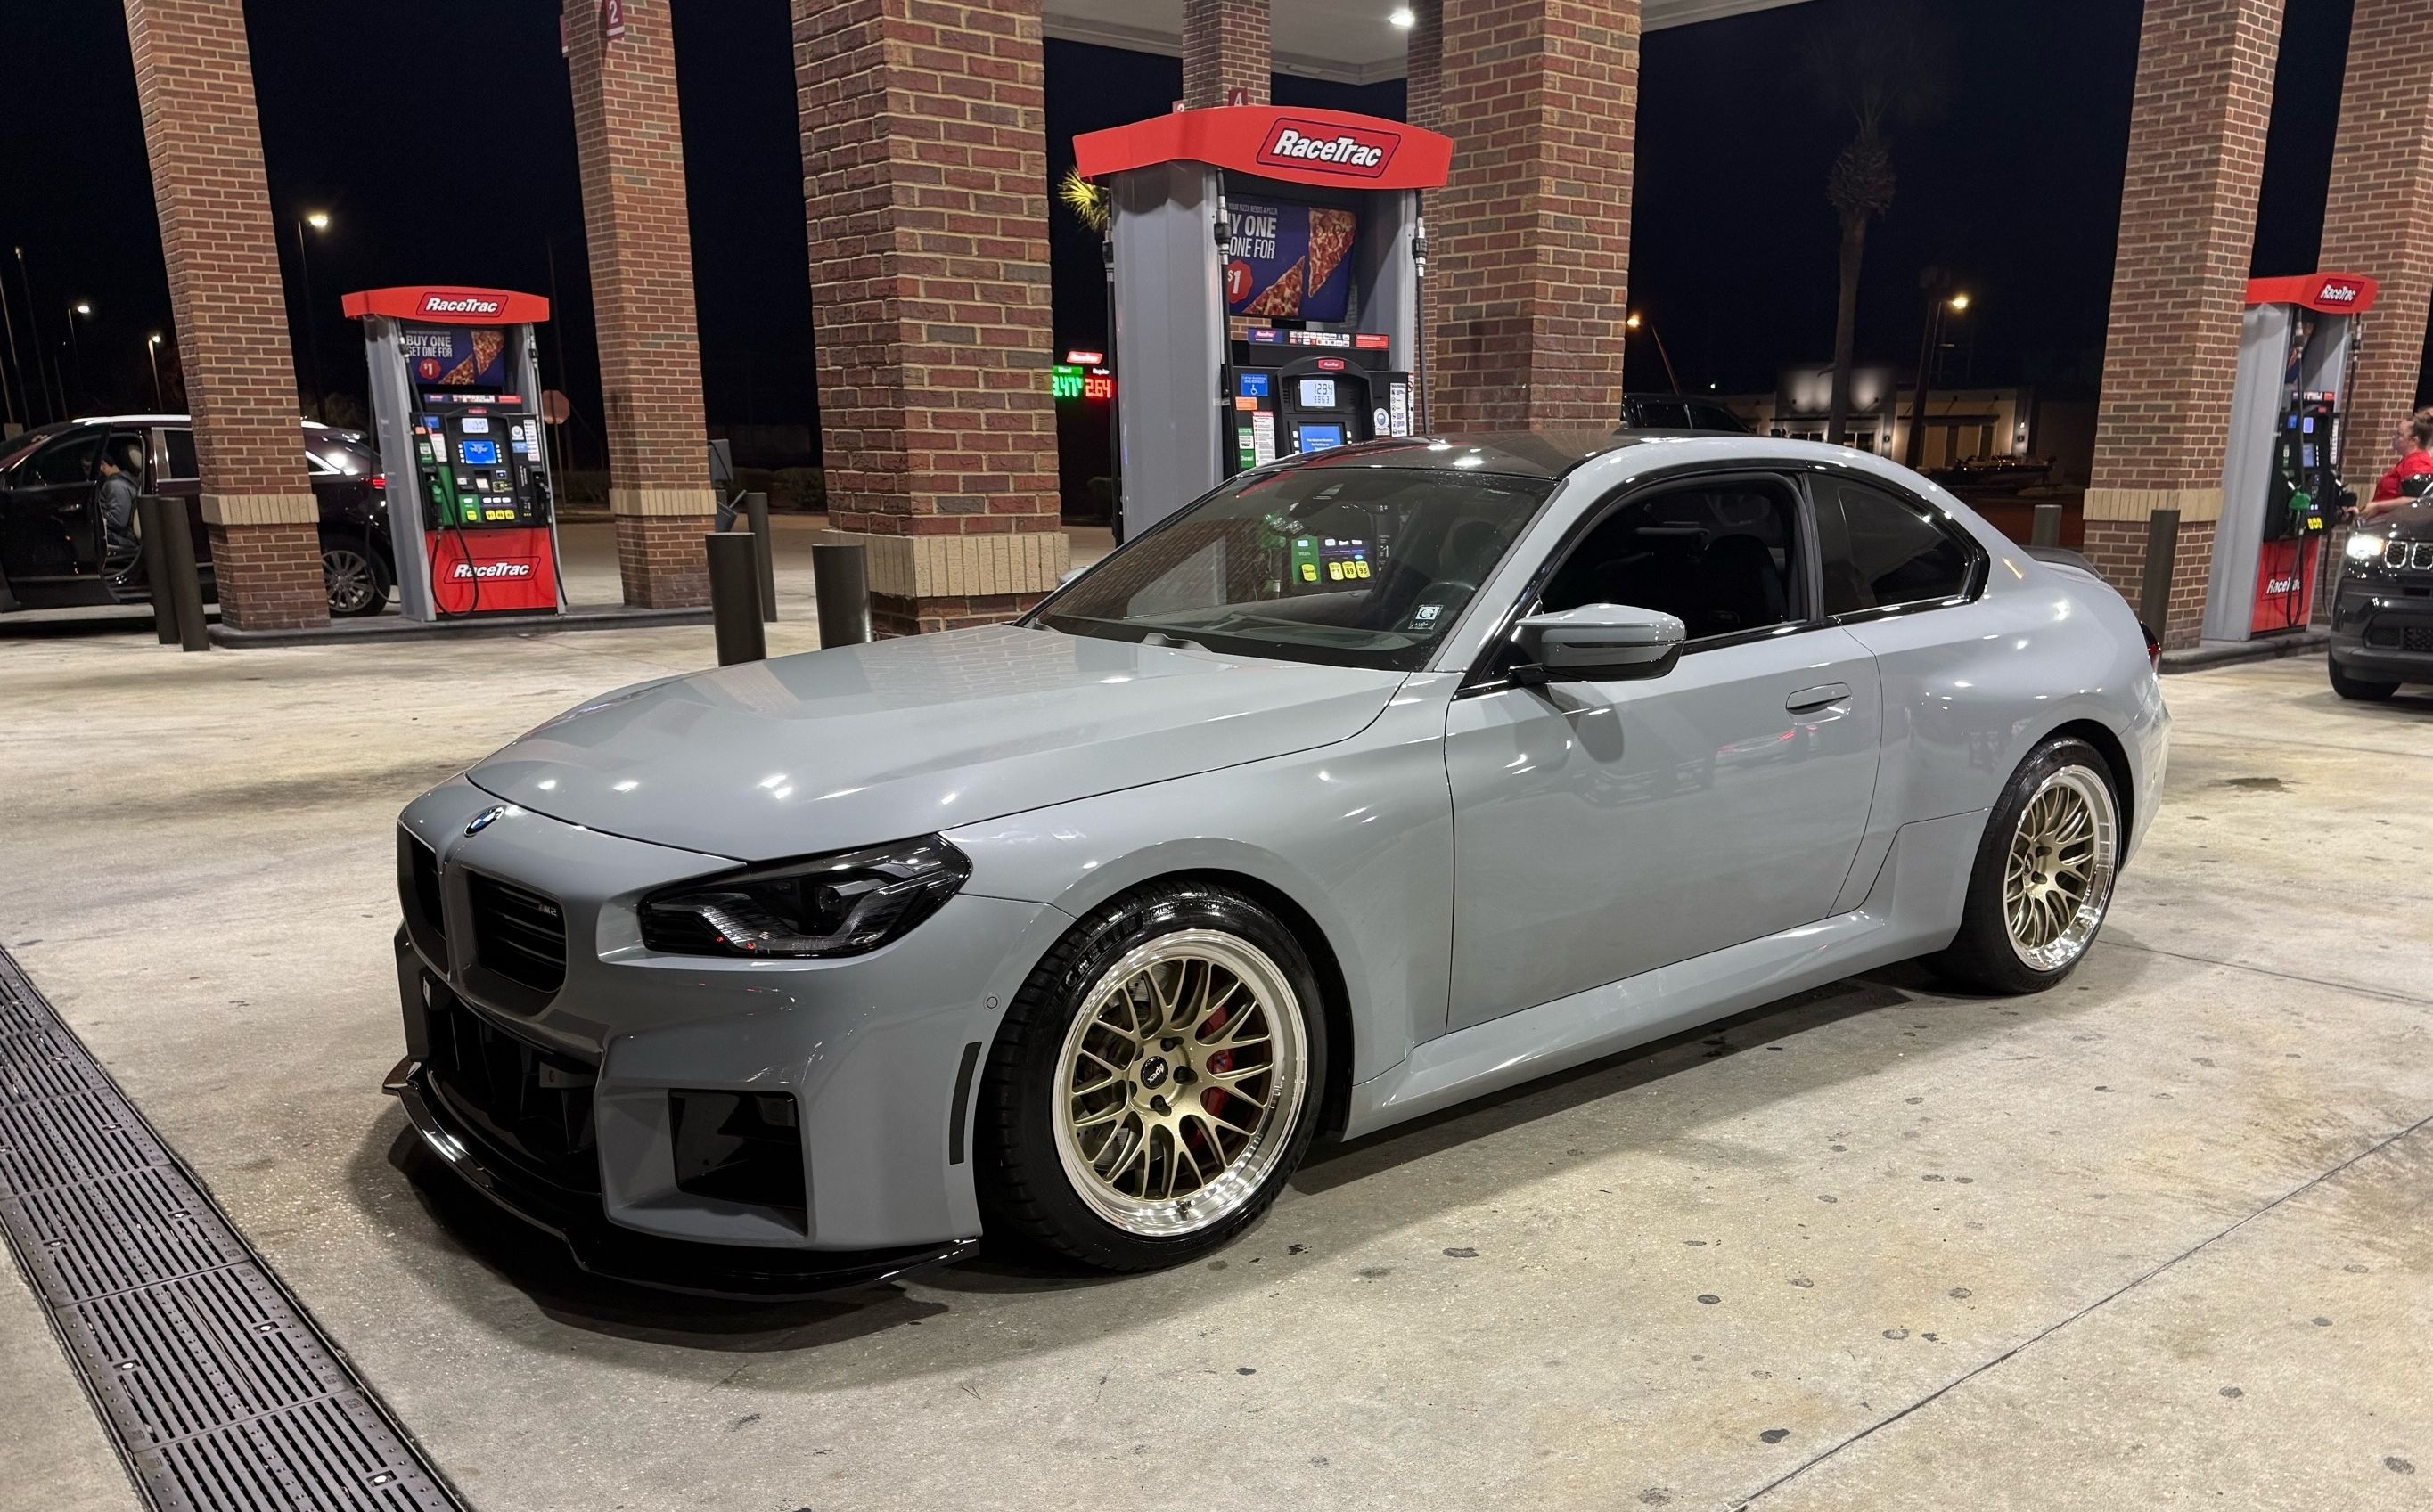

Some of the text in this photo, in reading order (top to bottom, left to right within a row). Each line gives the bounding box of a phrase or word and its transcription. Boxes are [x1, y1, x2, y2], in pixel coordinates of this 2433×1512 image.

[609, 0, 618, 24] 2
[1274, 129, 1383, 167] RaceTrac
[1244, 215, 1277, 238] ONE
[1230, 236, 1275, 259] ONE FOR
[1227, 270, 1241, 294] $1
[2320, 284, 2356, 301] RaceTrac
[426, 298, 498, 313] RaceTrac
[406, 335, 452, 347] BUY ONE
[422, 347, 438, 357] ONE
[438, 347, 453, 357] FOR
[1419, 608, 1436, 619] G
